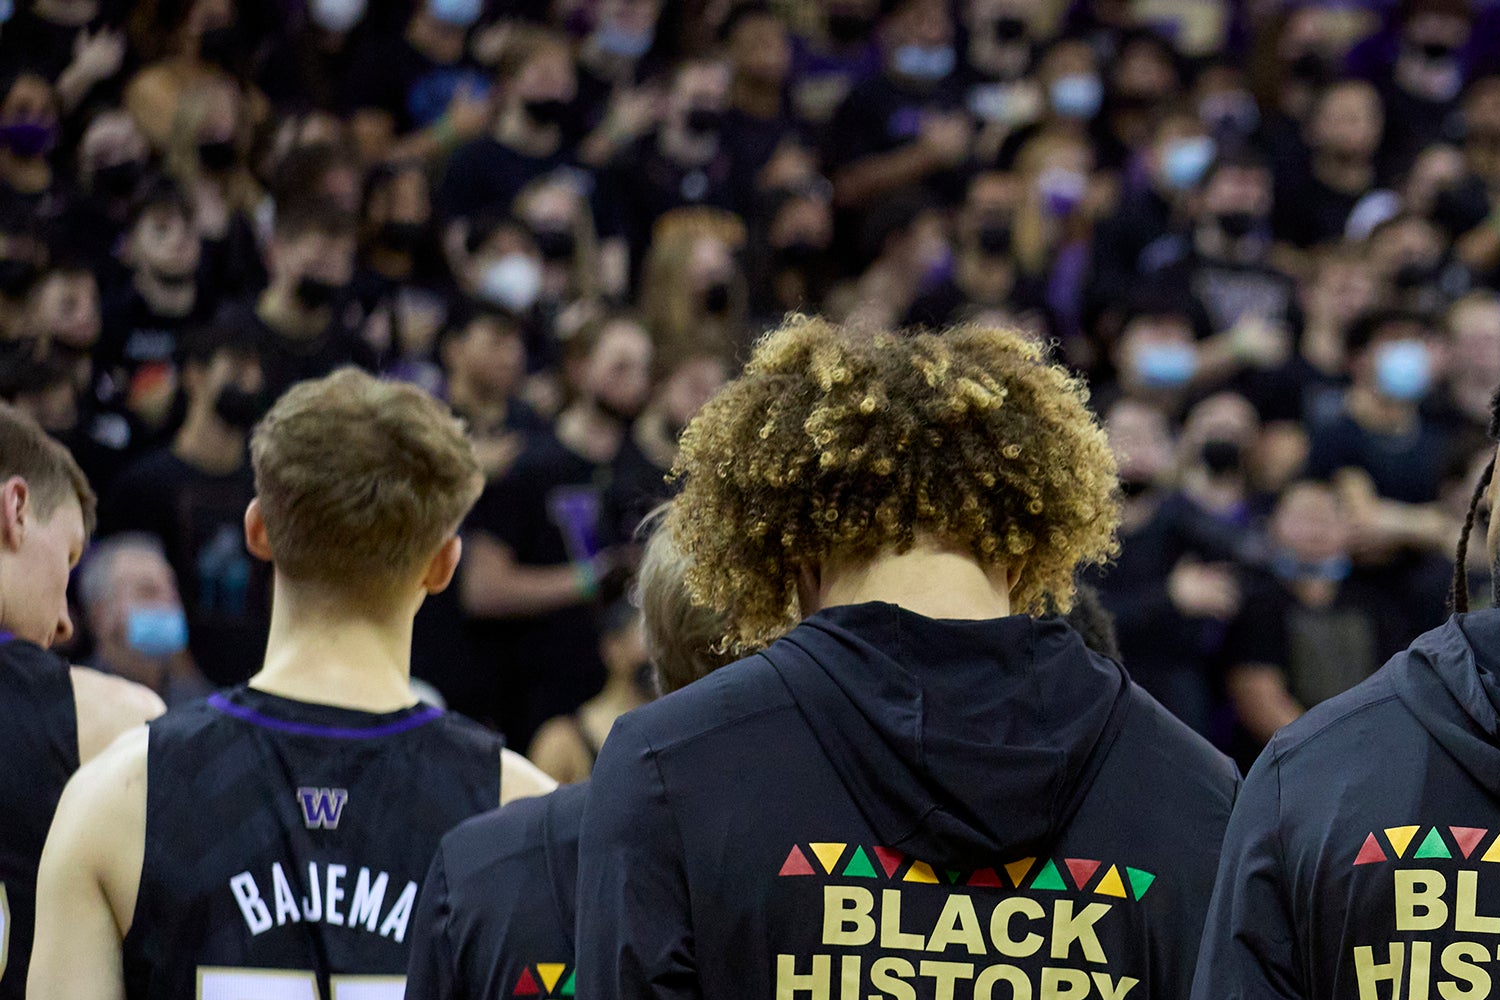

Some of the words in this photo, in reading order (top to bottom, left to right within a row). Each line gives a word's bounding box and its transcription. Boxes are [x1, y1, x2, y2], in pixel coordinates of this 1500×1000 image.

[297, 786, 349, 829] W
[229, 861, 418, 943] BAJEMA
[822, 884, 1113, 964] BLACK
